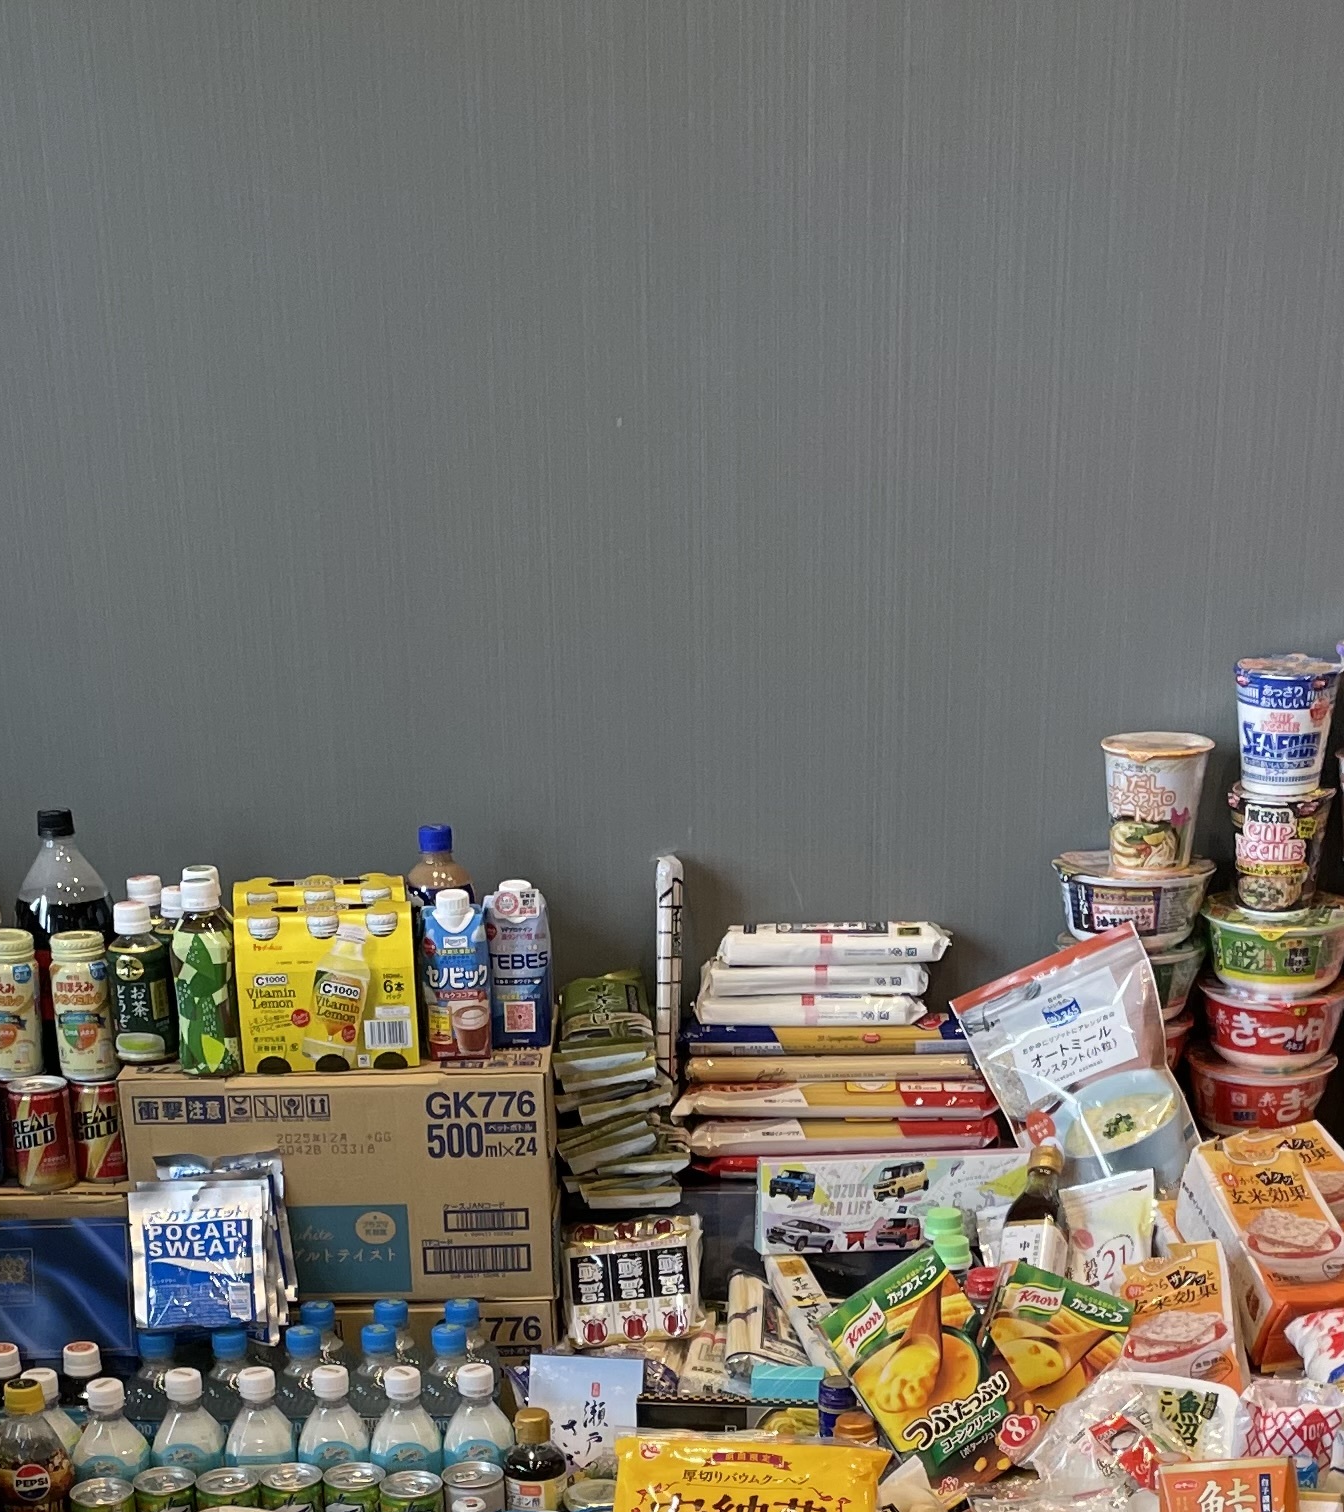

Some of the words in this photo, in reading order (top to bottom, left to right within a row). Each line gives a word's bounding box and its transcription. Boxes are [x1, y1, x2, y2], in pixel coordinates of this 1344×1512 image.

[1262, 685, 1303, 697] あっさり
[1242, 723, 1319, 759] SEAFOOD
[255, 975, 287, 986] C1000
[383, 977, 404, 994] 6本
[427, 965, 489, 989] セノビック
[247, 987, 296, 999] Vitamin
[321, 982, 360, 998] C1000
[252, 998, 294, 1009] Lemon
[316, 996, 360, 1014] Vitamin
[316, 1008, 356, 1023] Lemon
[1029, 1026, 1112, 1069] オートミール
[135, 1097, 224, 1123] 衝撃注意
[426, 1091, 536, 1119] GK776
[12, 1115, 55, 1132] REAL
[486, 1122, 535, 1133] ペットボトル
[14, 1130, 57, 1150] GOLD
[826, 1183, 869, 1199] SUZUKI
[1226, 1180, 1310, 1206] 玄米効果
[820, 1200, 845, 1215] CAR
[848, 1200, 871, 1215] LIFE
[147, 1223, 249, 1242] POCARI
[148, 1239, 239, 1257] SWEAT
[1017, 1288, 1061, 1308] Knorr
[845, 1299, 887, 1348] Knorr
[904, 1375, 1012, 1447] つぶたっぷり
[940, 1408, 1002, 1455] コーンクリーム
[16, 1476, 50, 1486] PEPSI
[682, 1468, 811, 1486] 厚切りバウムクーヘン
